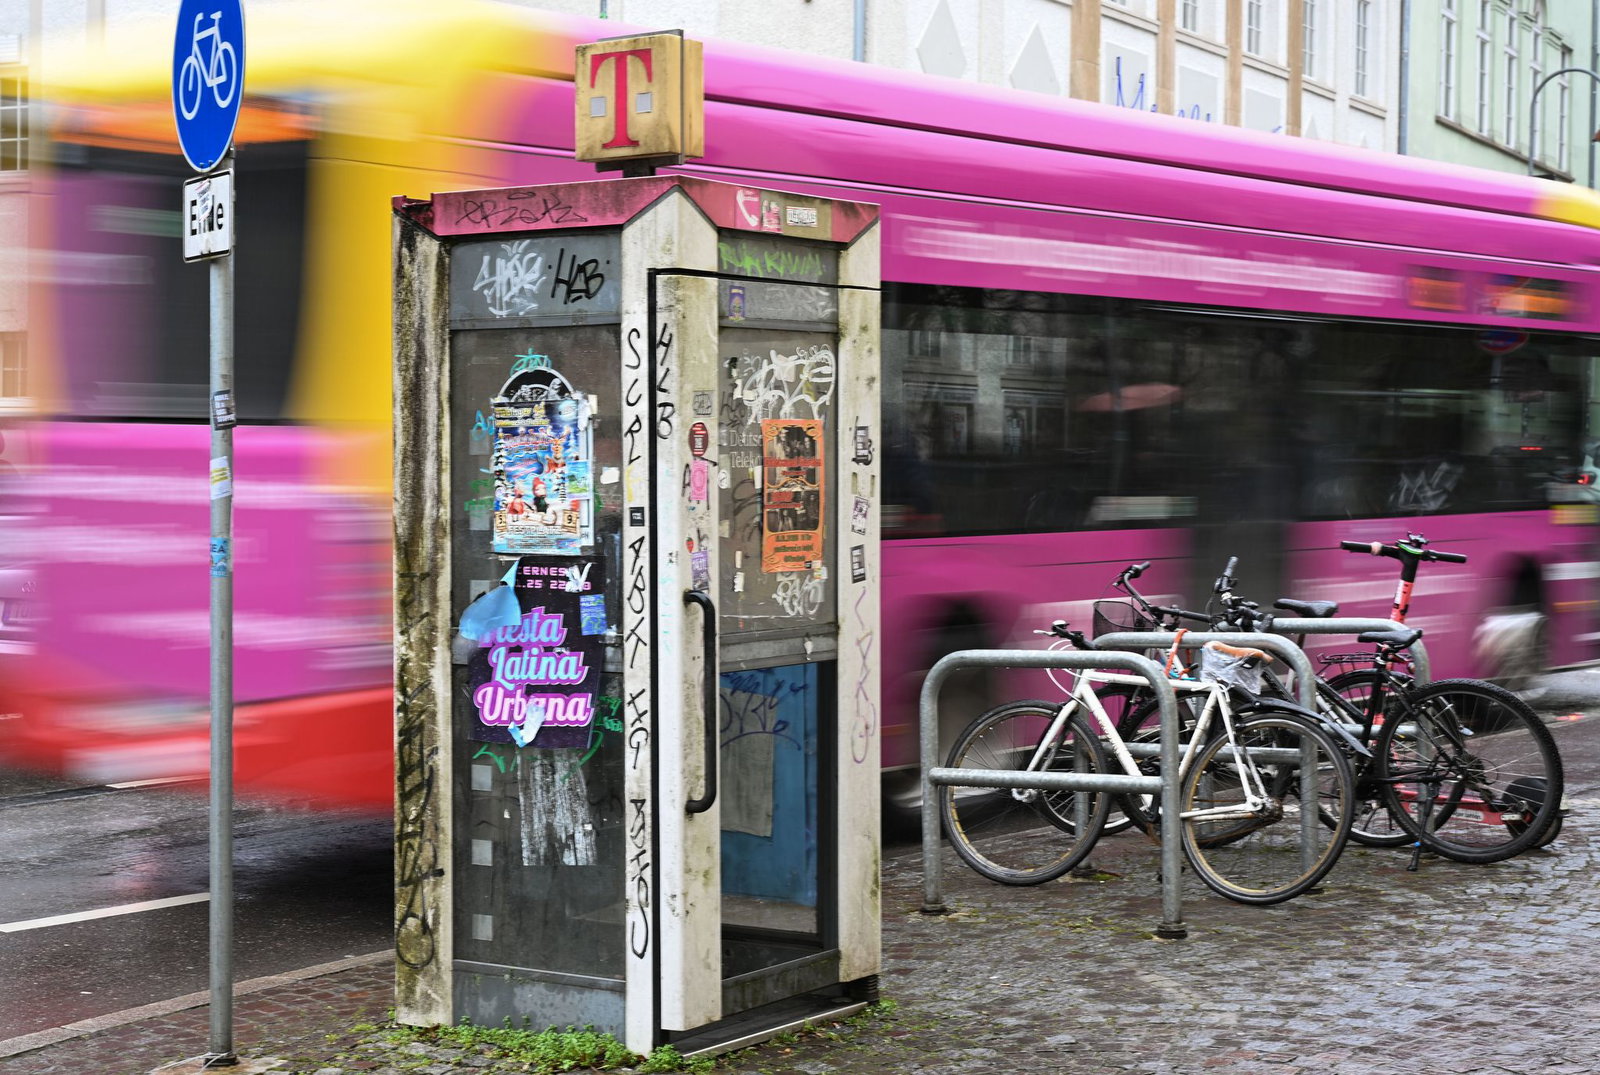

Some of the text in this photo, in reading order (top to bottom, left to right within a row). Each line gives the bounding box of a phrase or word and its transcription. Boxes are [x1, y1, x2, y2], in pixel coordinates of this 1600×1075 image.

[590, 48, 653, 149] T
[517, 566, 567, 577] ERNES
[491, 646, 582, 691] Latina
